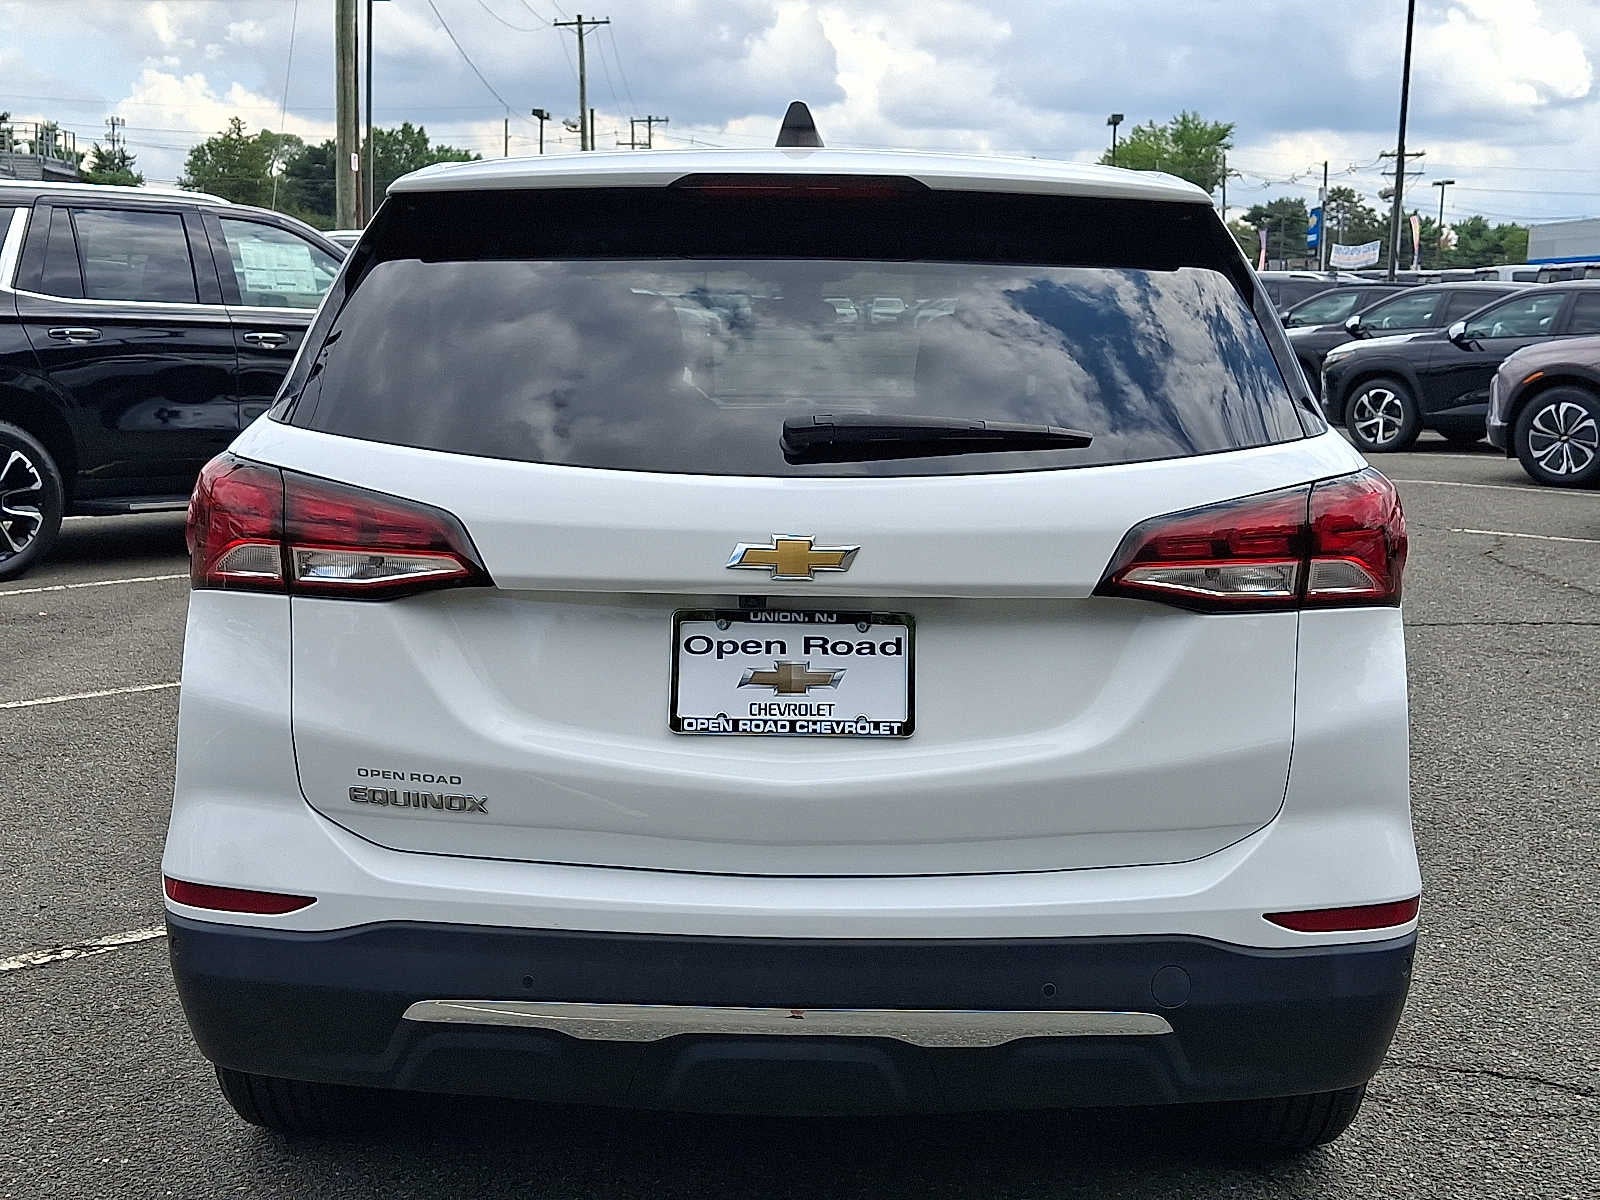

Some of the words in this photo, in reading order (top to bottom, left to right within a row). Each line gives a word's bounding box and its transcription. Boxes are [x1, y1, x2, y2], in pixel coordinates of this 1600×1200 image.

[815, 613, 837, 624] NJ
[683, 635, 787, 660] Open
[803, 636, 903, 656] Road
[749, 702, 836, 717] CHEVROLET
[683, 719, 731, 732] OPEN
[738, 720, 790, 733] ROAD
[795, 721, 902, 735] CHEVROLET
[357, 768, 405, 781] OPEN
[410, 773, 462, 785] ROAD
[348, 785, 489, 815] EQUINOX
